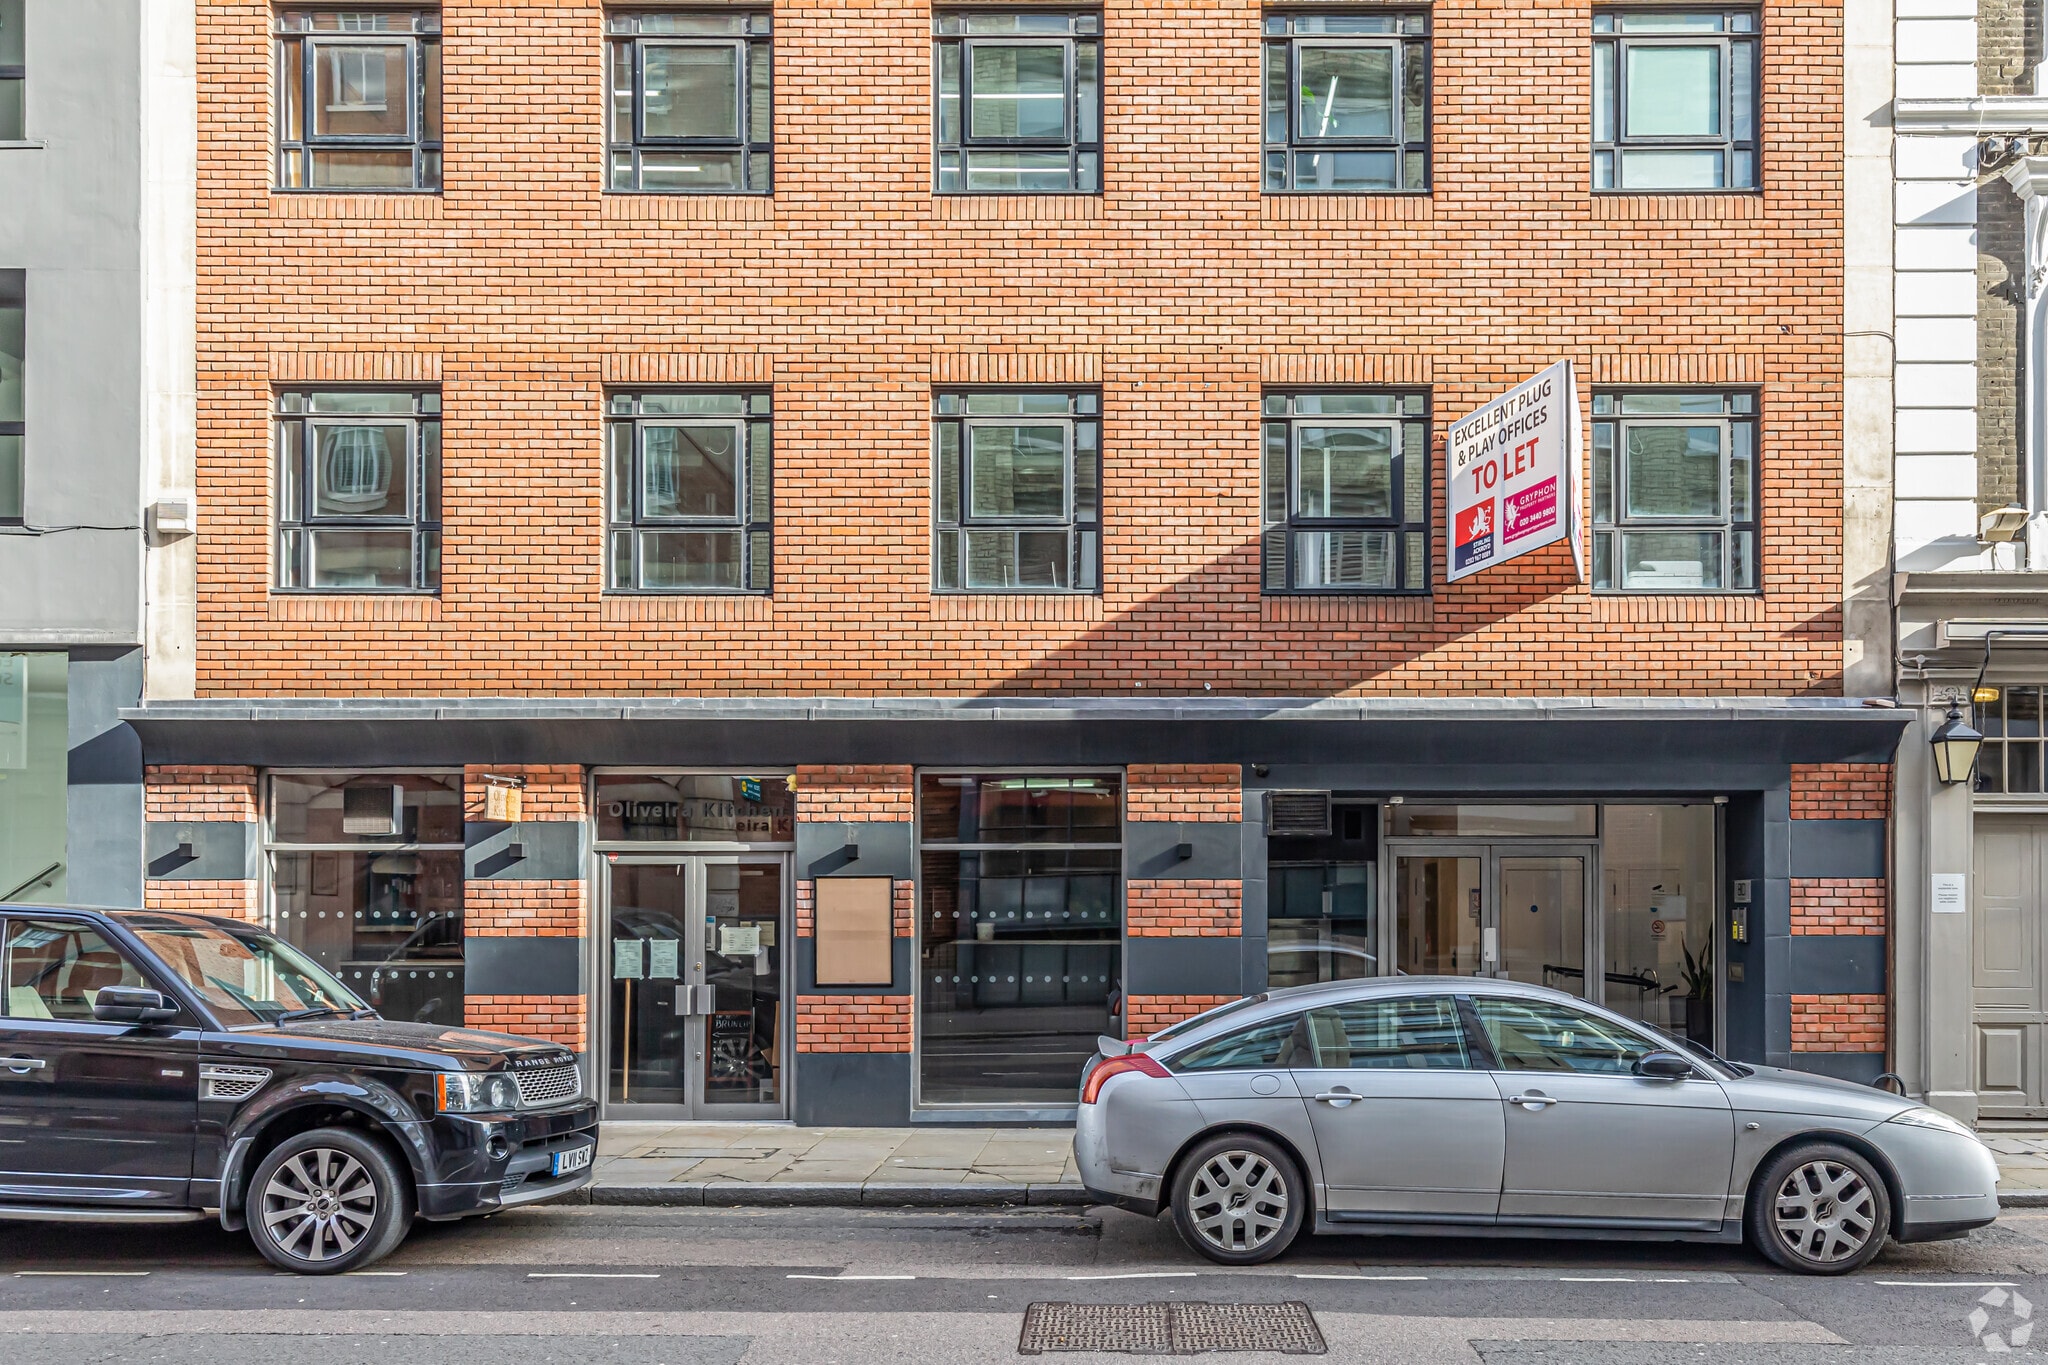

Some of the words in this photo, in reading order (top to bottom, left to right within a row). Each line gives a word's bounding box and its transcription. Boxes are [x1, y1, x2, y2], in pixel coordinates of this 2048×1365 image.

[1455, 399, 1516, 447] EXCELLENT
[1519, 379, 1551, 412] PLUG
[1458, 450, 1466, 466] &
[1469, 433, 1495, 461] PLAY
[1498, 405, 1547, 445] OFFICES
[1472, 459, 1498, 494] TO
[1504, 437, 1539, 481] LET
[1520, 482, 1556, 505] GRYPHON
[1519, 516, 1529, 527] 020
[1542, 505, 1555, 517] 9800
[1473, 536, 1490, 548] STIRLING
[1473, 542, 1491, 555] ACKROYD
[608, 800, 692, 817] Oliveira
[704, 800, 784, 817] Kitchen
[514, 1058, 551, 1067] RANGE
[553, 1055, 574, 1064] ROVER
